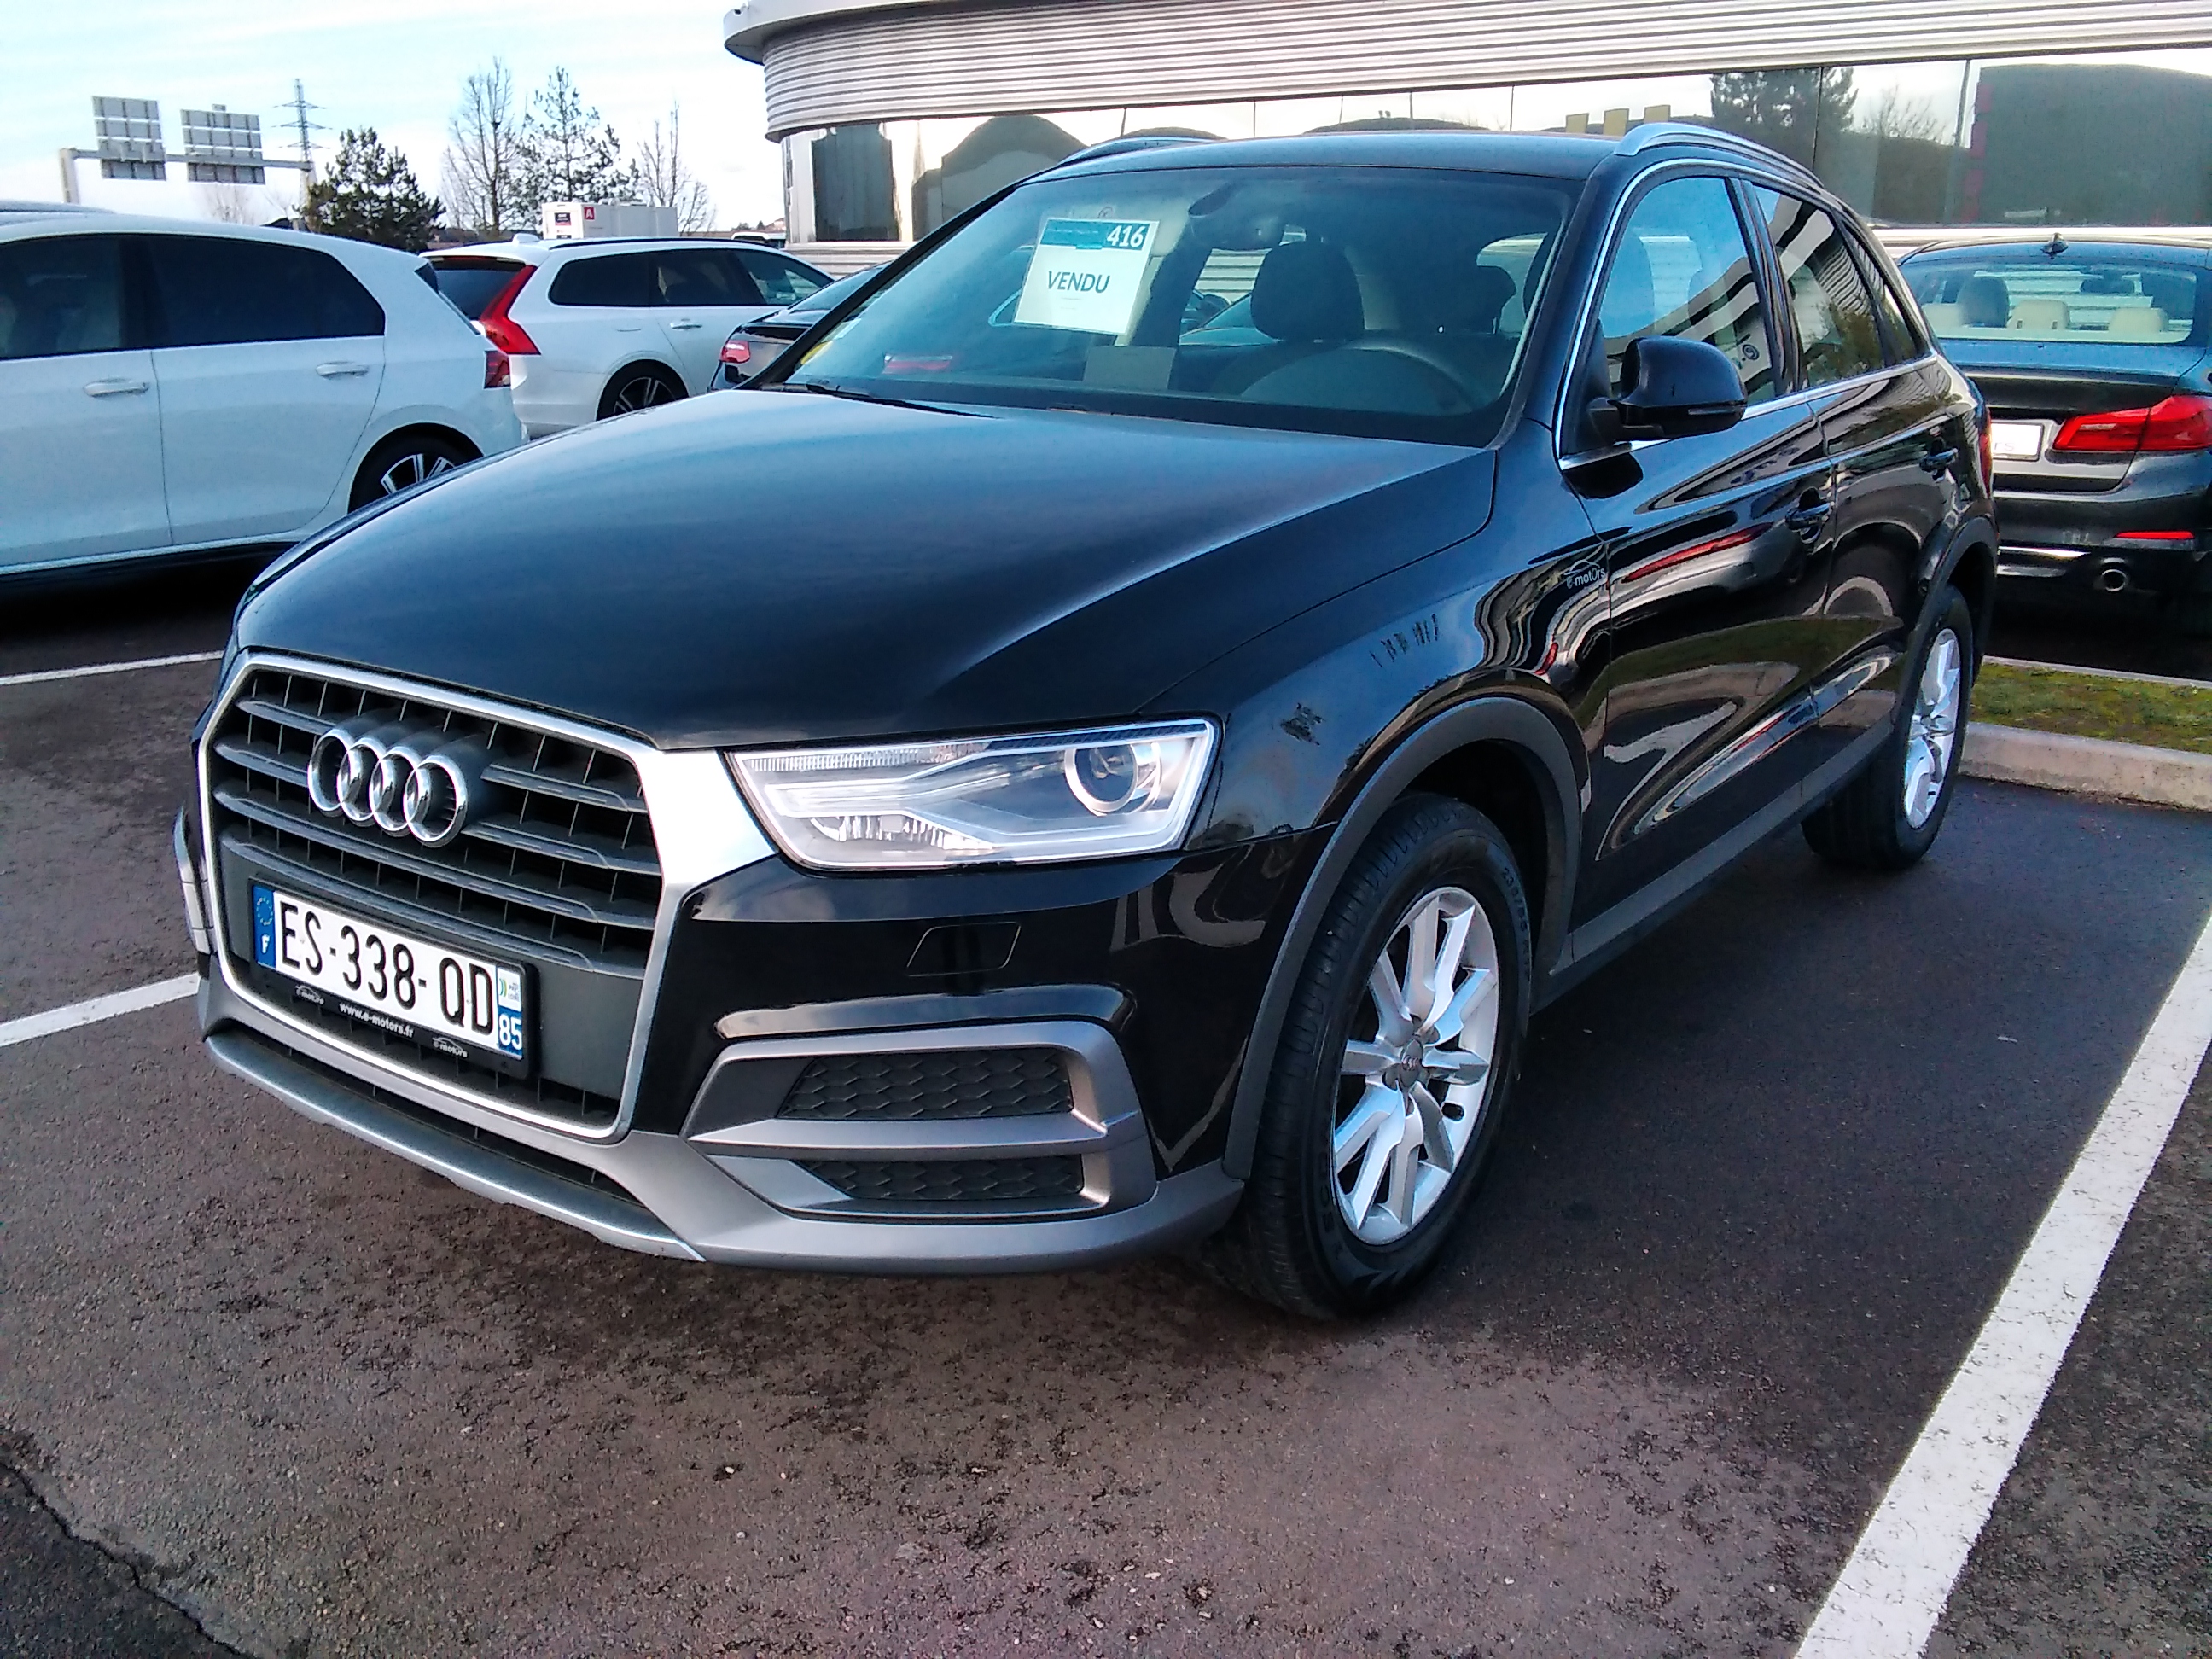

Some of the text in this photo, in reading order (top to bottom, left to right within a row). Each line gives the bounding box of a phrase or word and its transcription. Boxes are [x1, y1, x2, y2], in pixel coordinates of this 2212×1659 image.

[1106, 225, 1145, 247] 416
[1048, 271, 1110, 294] VENDU
[260, 934, 271, 953] F
[279, 900, 494, 1036] ES-338-QD
[339, 1003, 414, 1039] www.e-motors.fr
[498, 1013, 523, 1050] 85
